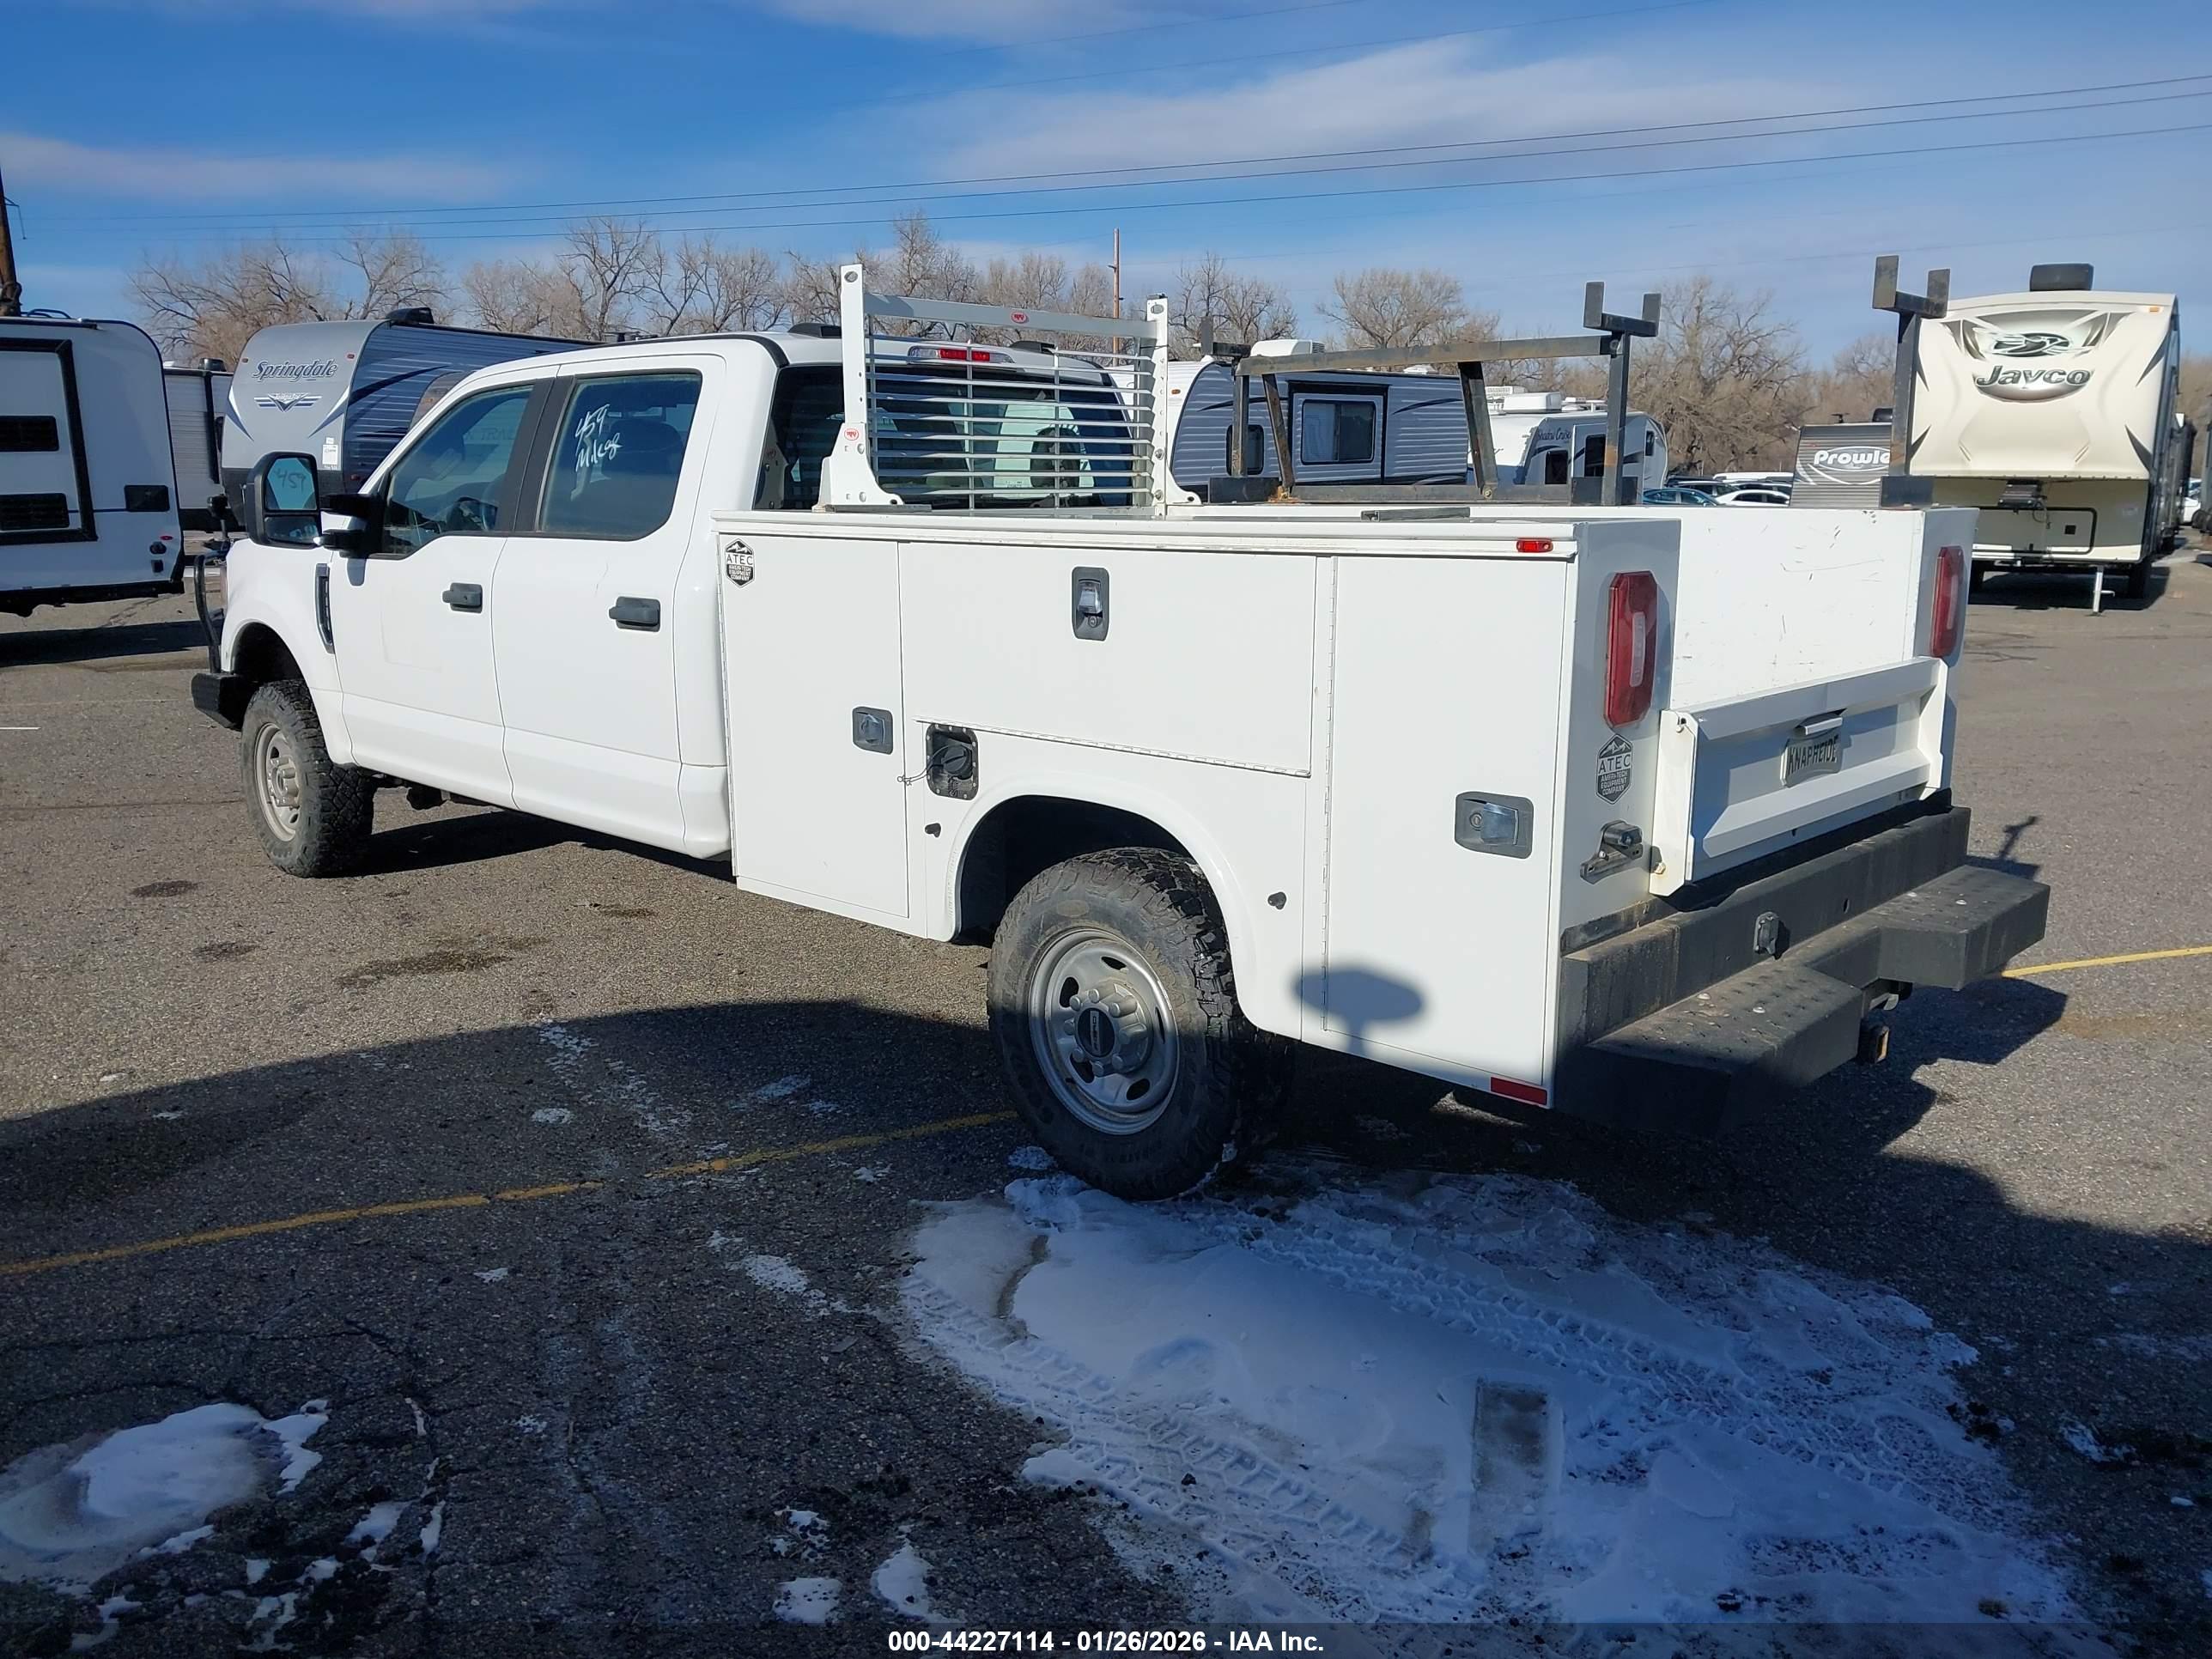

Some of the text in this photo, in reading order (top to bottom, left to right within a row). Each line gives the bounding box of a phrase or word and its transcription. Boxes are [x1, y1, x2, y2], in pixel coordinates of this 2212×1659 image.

[252, 359, 337, 383] Springdale
[1976, 365, 2091, 387] Jayco
[1814, 450, 1890, 465] Prowle
[726, 554, 753, 565] ATEC
[1599, 754, 1631, 774] ATEC
